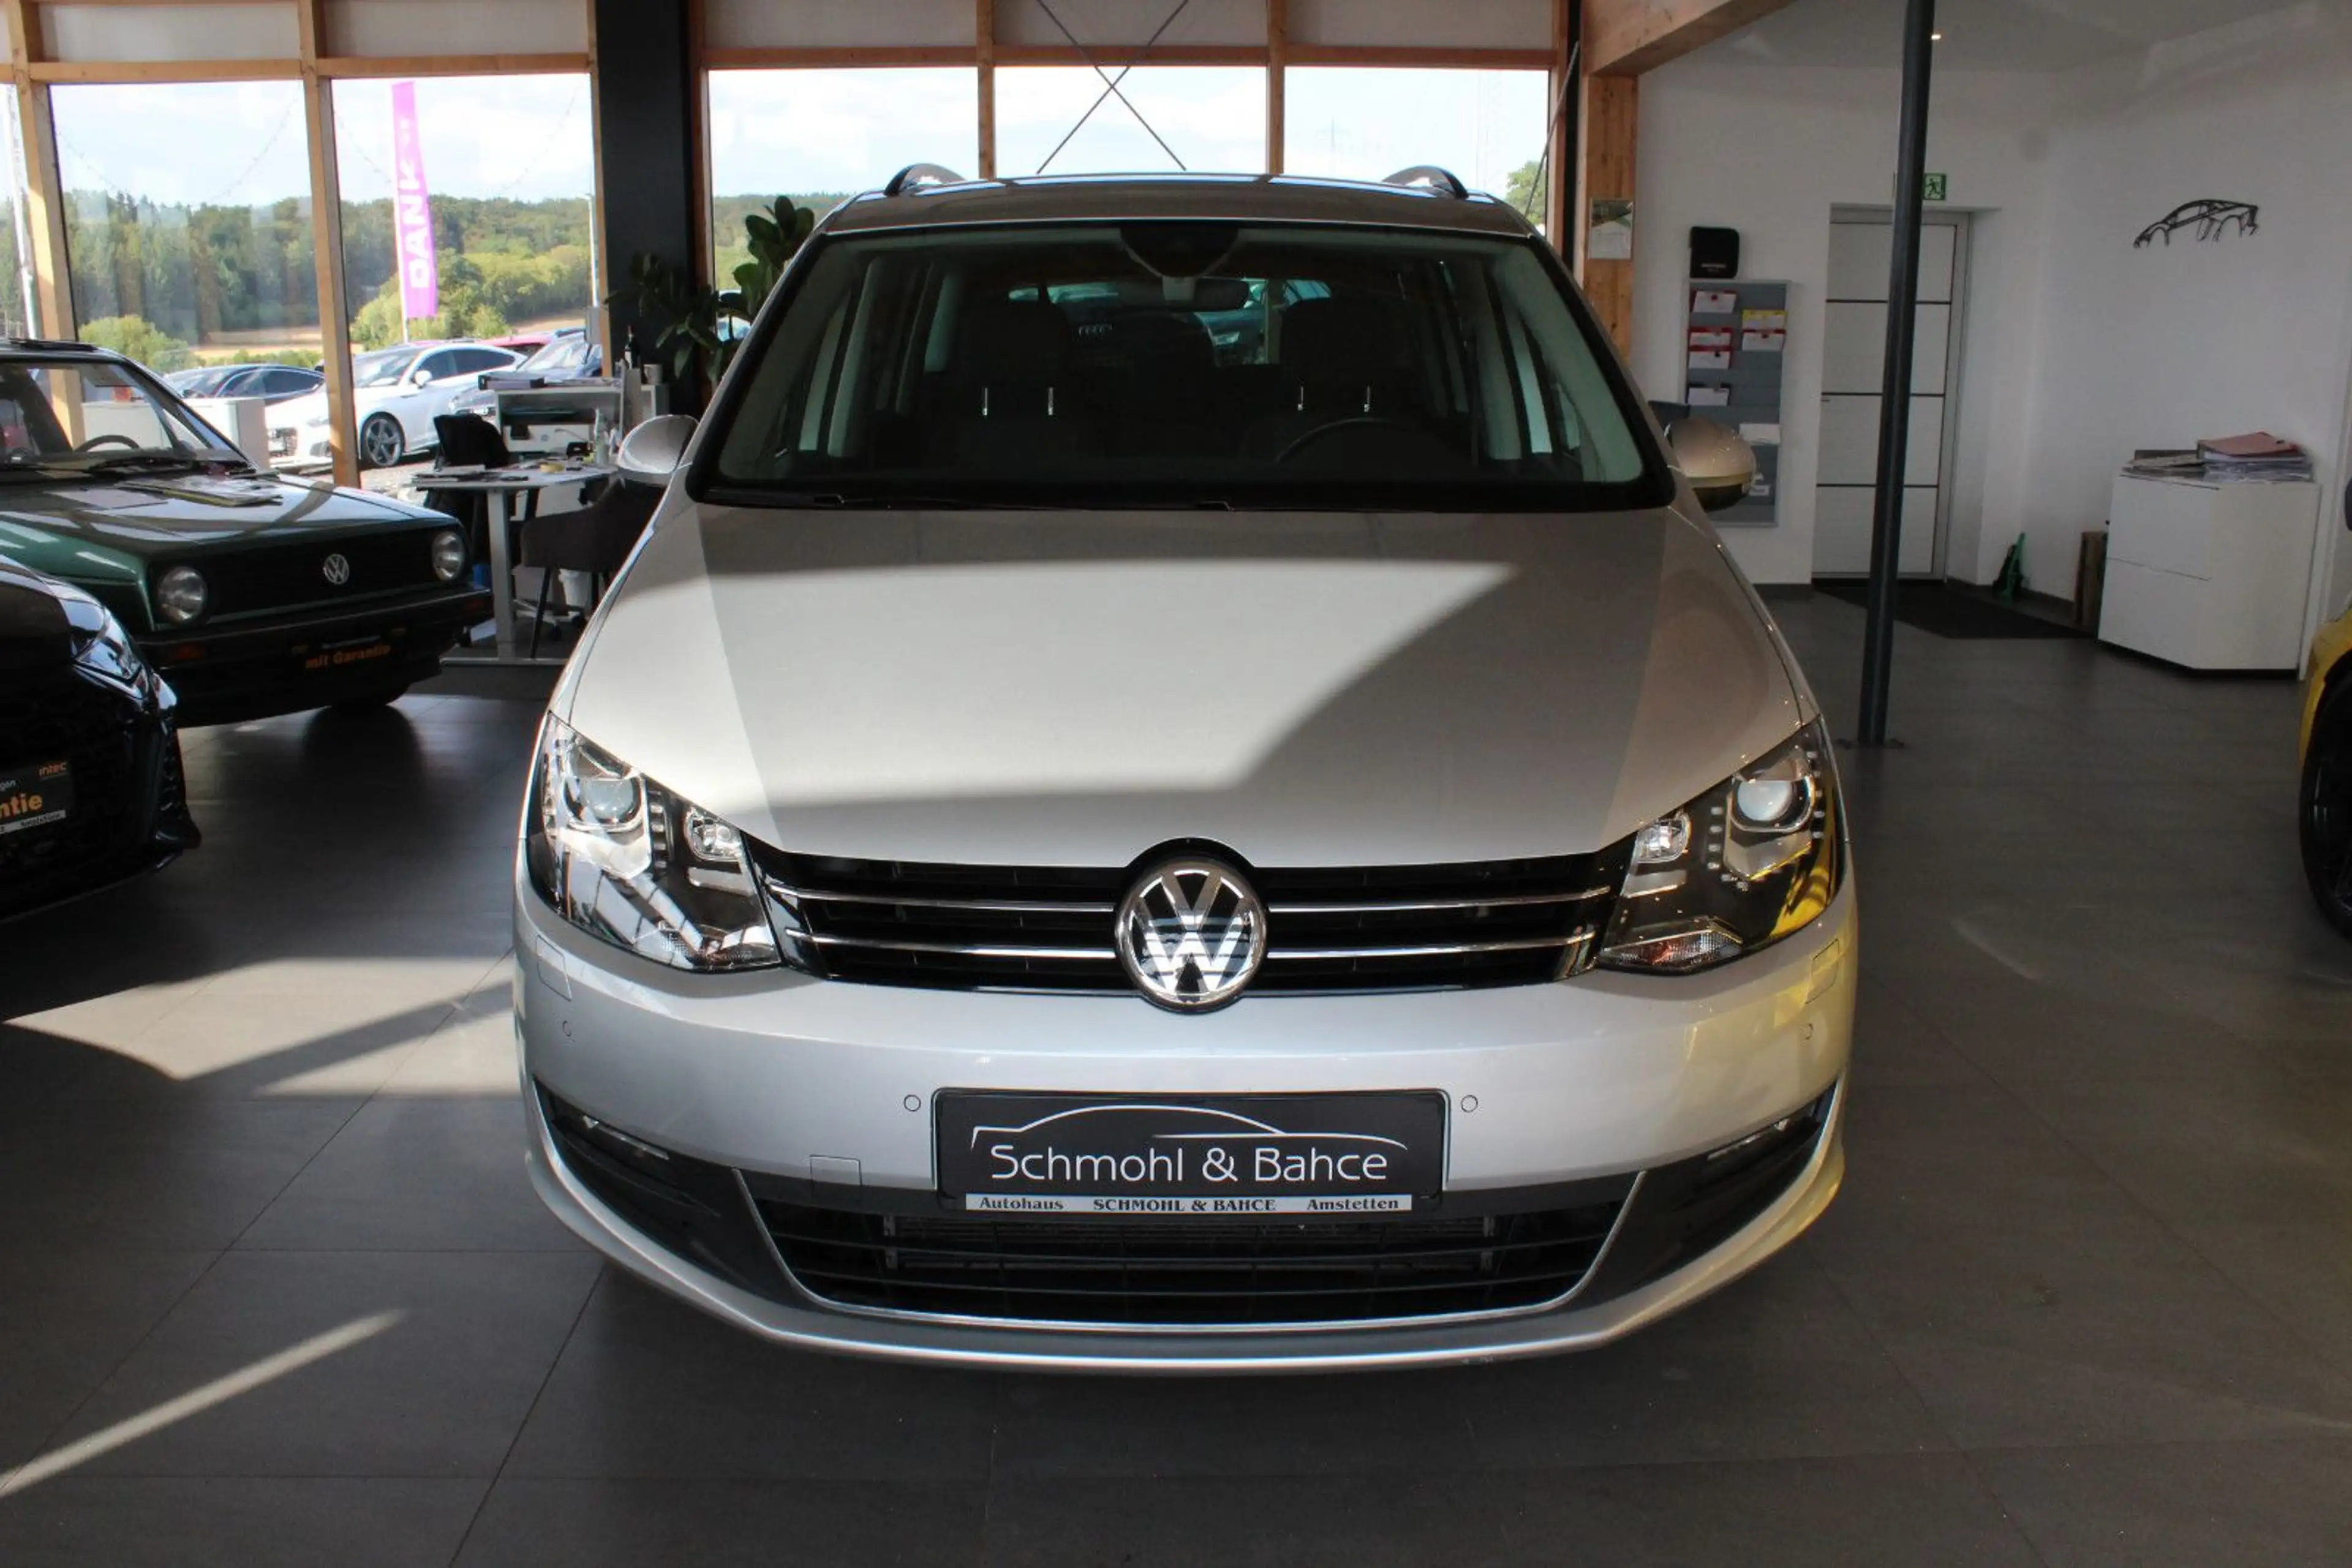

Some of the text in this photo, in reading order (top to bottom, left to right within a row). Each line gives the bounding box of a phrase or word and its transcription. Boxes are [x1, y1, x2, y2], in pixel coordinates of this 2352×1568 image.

[305, 654, 328, 669] mit
[990, 1144, 1388, 1182] Schmohl & Bahce
[979, 1197, 1399, 1212] Autohaus SCHMOHL & BAHCE Amstetten
